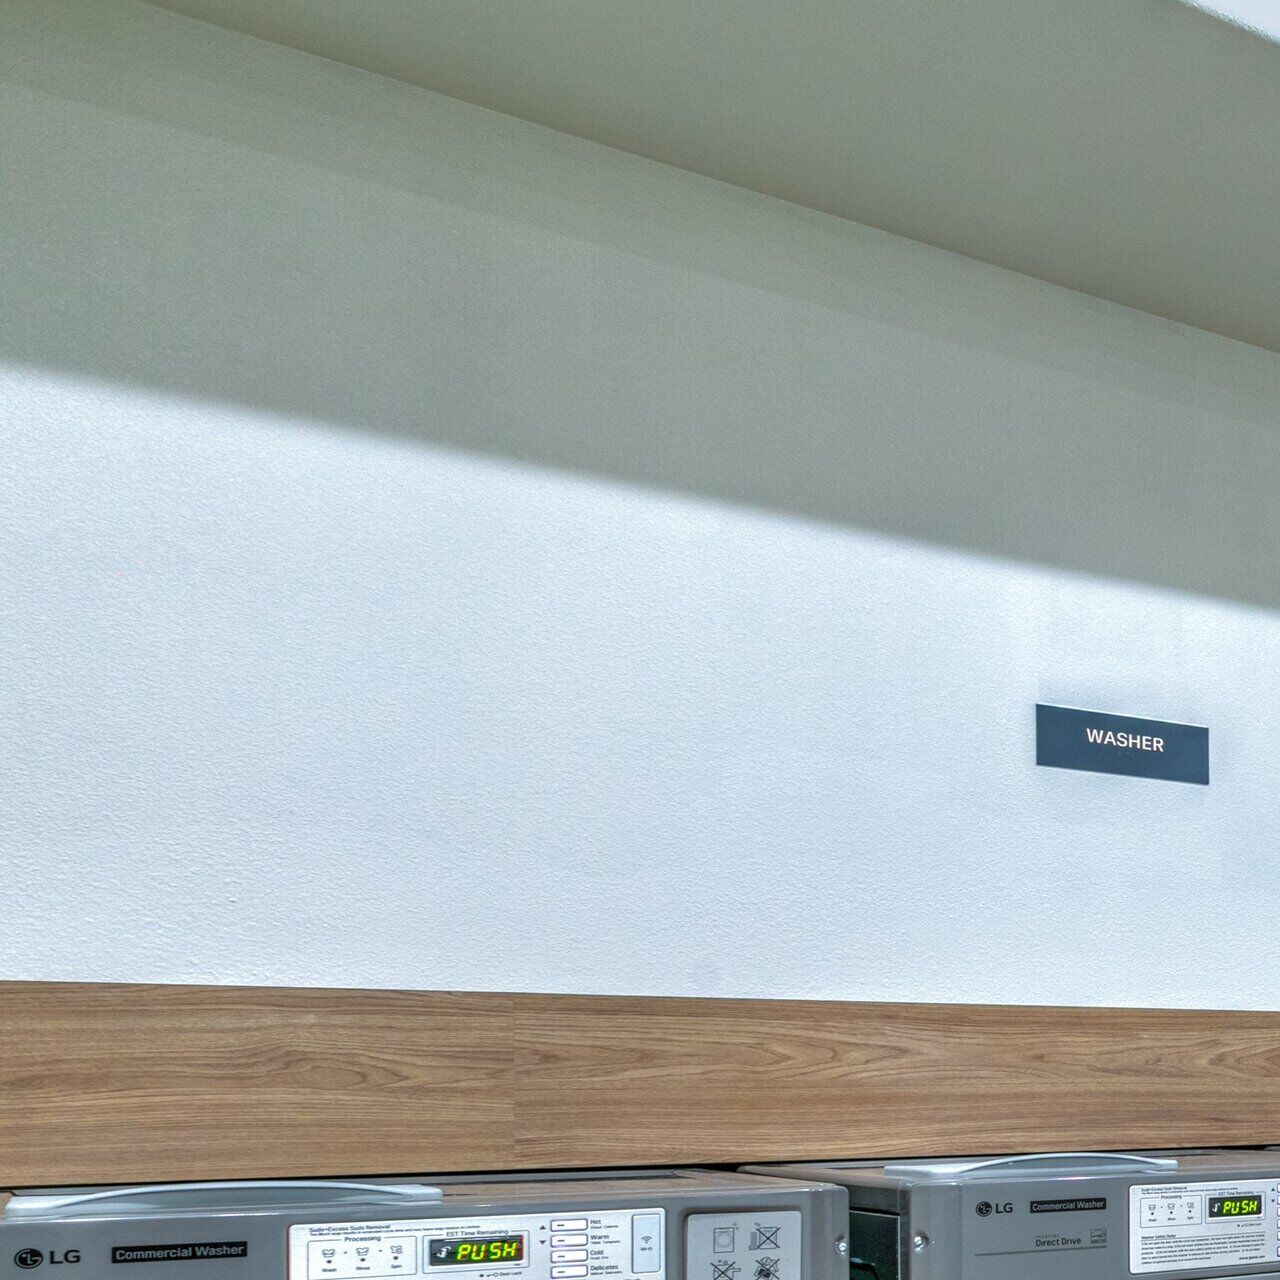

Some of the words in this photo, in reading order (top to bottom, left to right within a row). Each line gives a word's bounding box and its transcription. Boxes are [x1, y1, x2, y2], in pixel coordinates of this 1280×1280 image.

[1087, 728, 1164, 751] WASHER
[996, 1203, 1014, 1213] LG
[1033, 1202, 1076, 1211] Commercial
[1077, 1201, 1106, 1211] Washer
[1222, 1201, 1258, 1214] PUSH
[1036, 1239, 1060, 1247] Direct
[50, 1250, 81, 1264] LG
[116, 1247, 193, 1259] Commercial
[195, 1246, 245, 1256] Washer
[456, 1242, 518, 1260] PUSH
